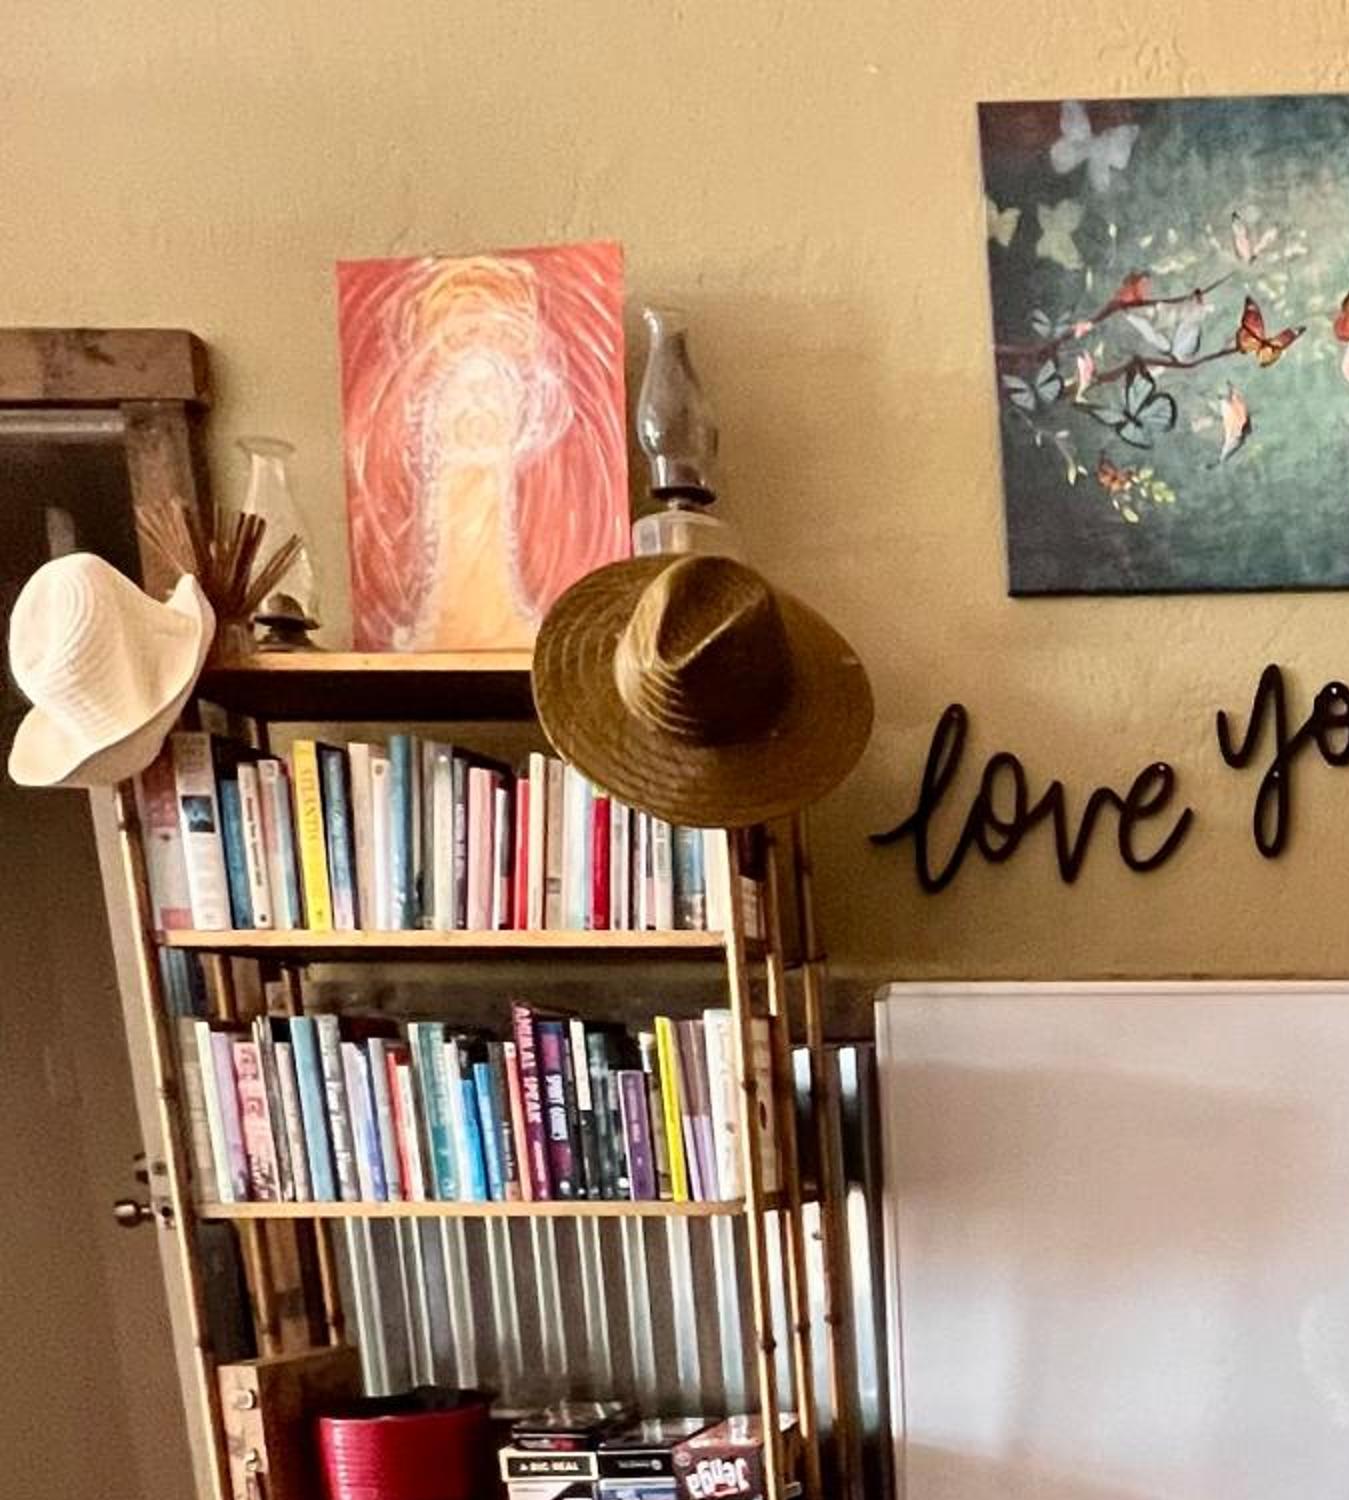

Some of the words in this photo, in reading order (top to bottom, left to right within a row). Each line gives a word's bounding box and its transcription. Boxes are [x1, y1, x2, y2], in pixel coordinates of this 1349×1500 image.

[869, 702, 1193, 895] love
[512, 1006, 536, 1071] ANIMAL
[523, 1076, 542, 1123] SPEAK
[685, 1457, 752, 1499] Jenga
